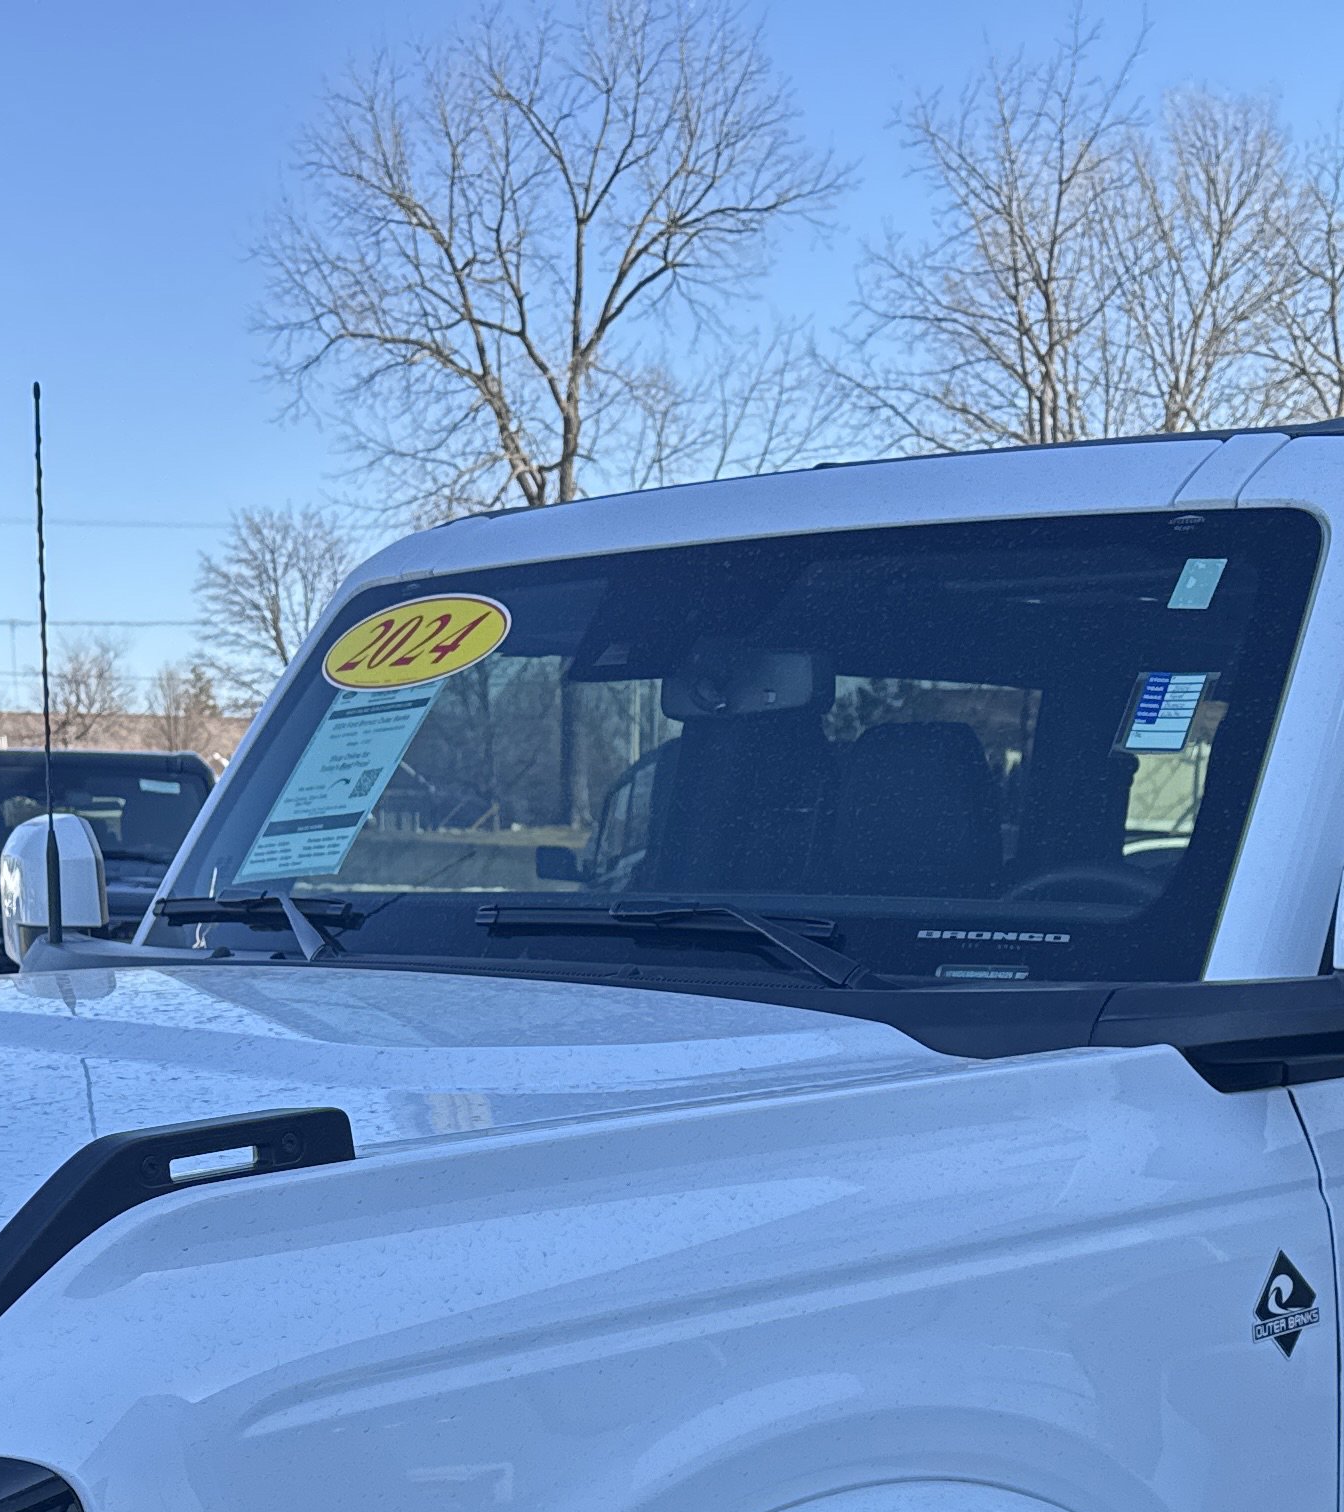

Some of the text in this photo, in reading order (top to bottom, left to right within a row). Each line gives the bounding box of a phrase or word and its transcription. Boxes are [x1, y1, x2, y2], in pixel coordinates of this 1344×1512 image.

[335, 611, 492, 672] 2024
[917, 930, 1070, 943] BRONCO
[1256, 1312, 1318, 1338] OUTER BANKS
